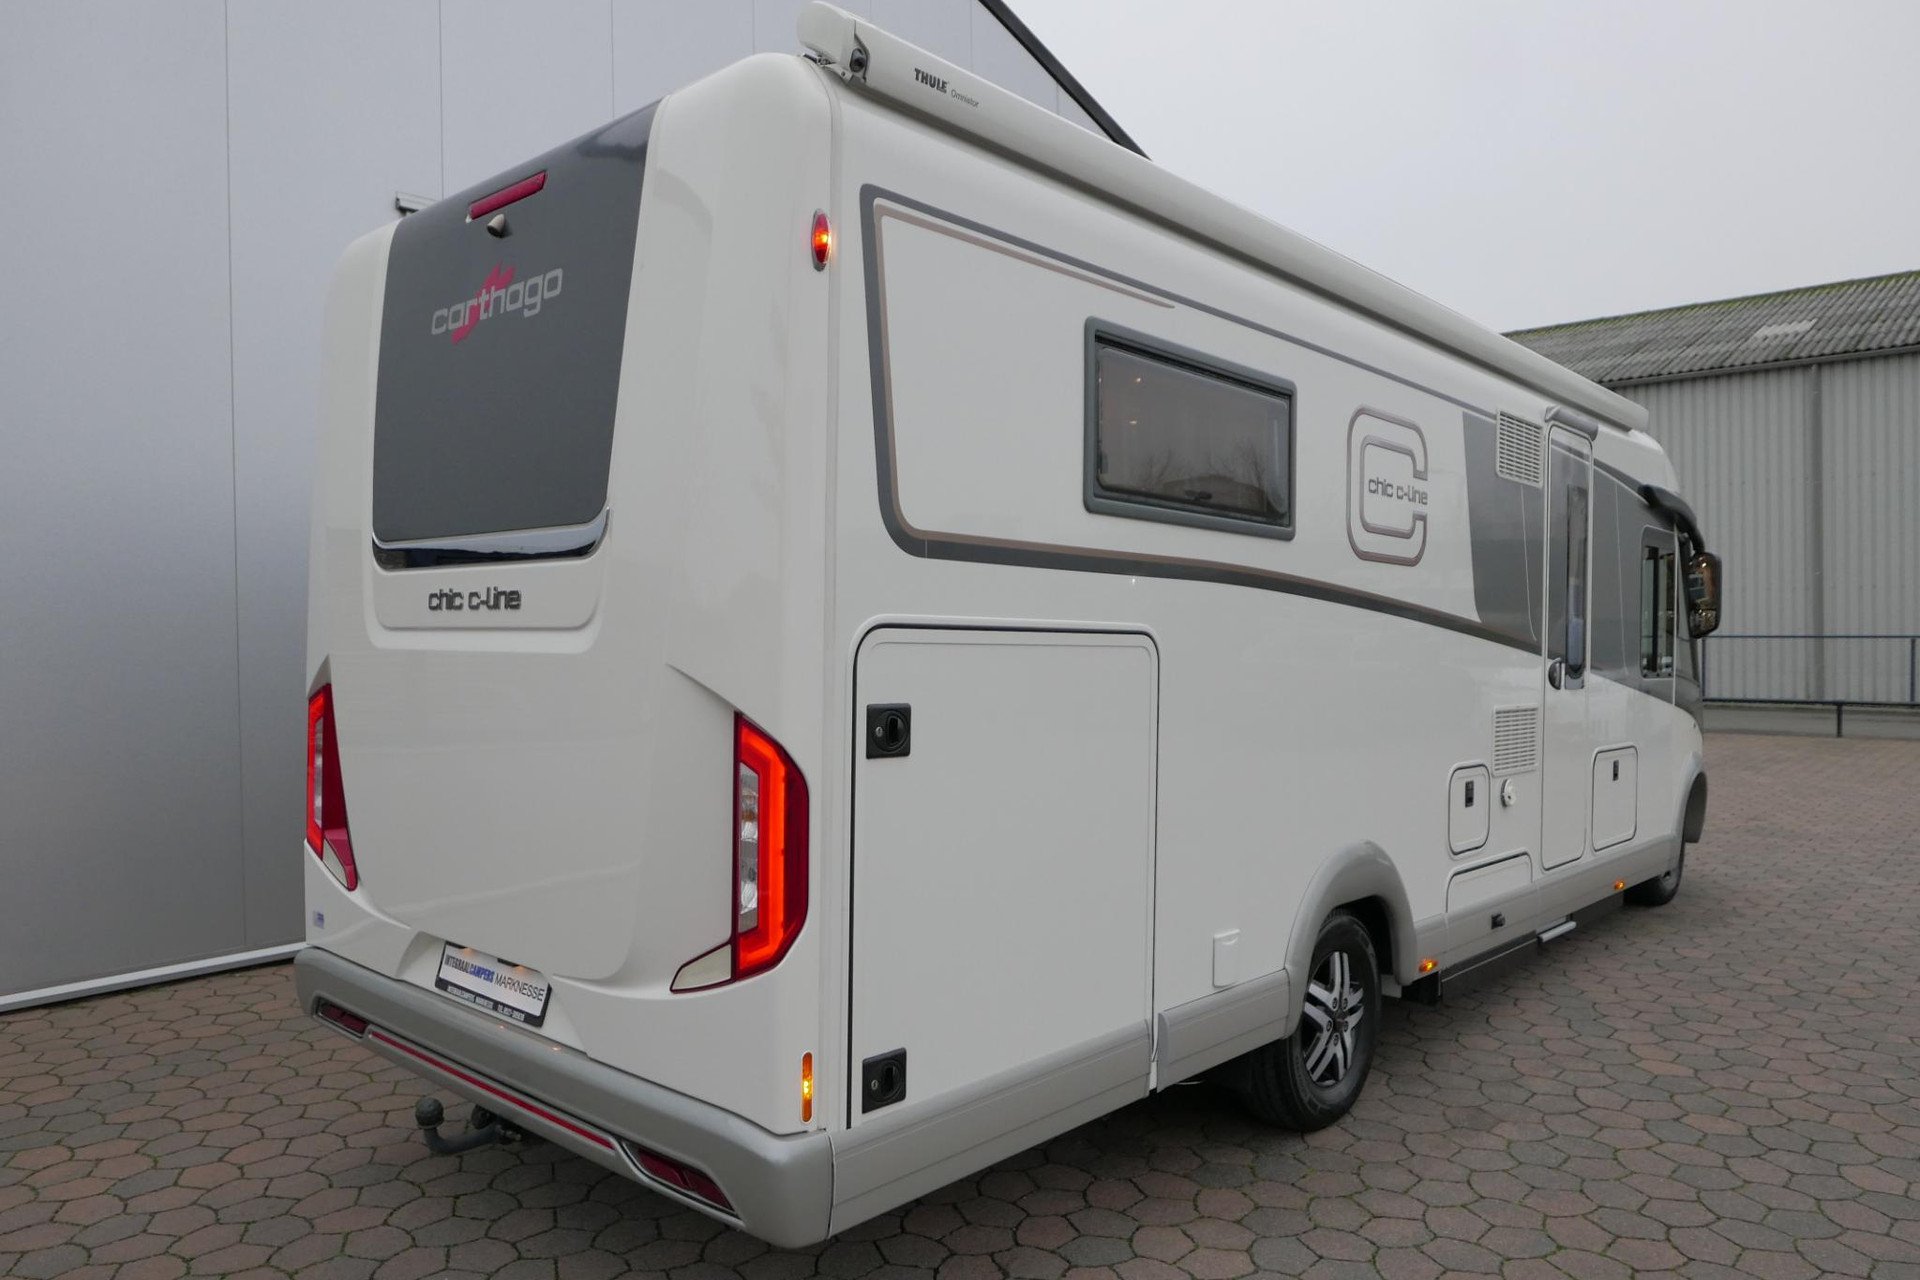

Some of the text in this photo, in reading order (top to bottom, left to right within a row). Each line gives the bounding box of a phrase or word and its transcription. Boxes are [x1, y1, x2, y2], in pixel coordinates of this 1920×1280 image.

[914, 67, 947, 93] THULE
[431, 268, 563, 335] carthago
[1368, 477, 1428, 505] chic c-line
[428, 586, 521, 610] chic c-line
[494, 973, 545, 1001] MARKNESSE
